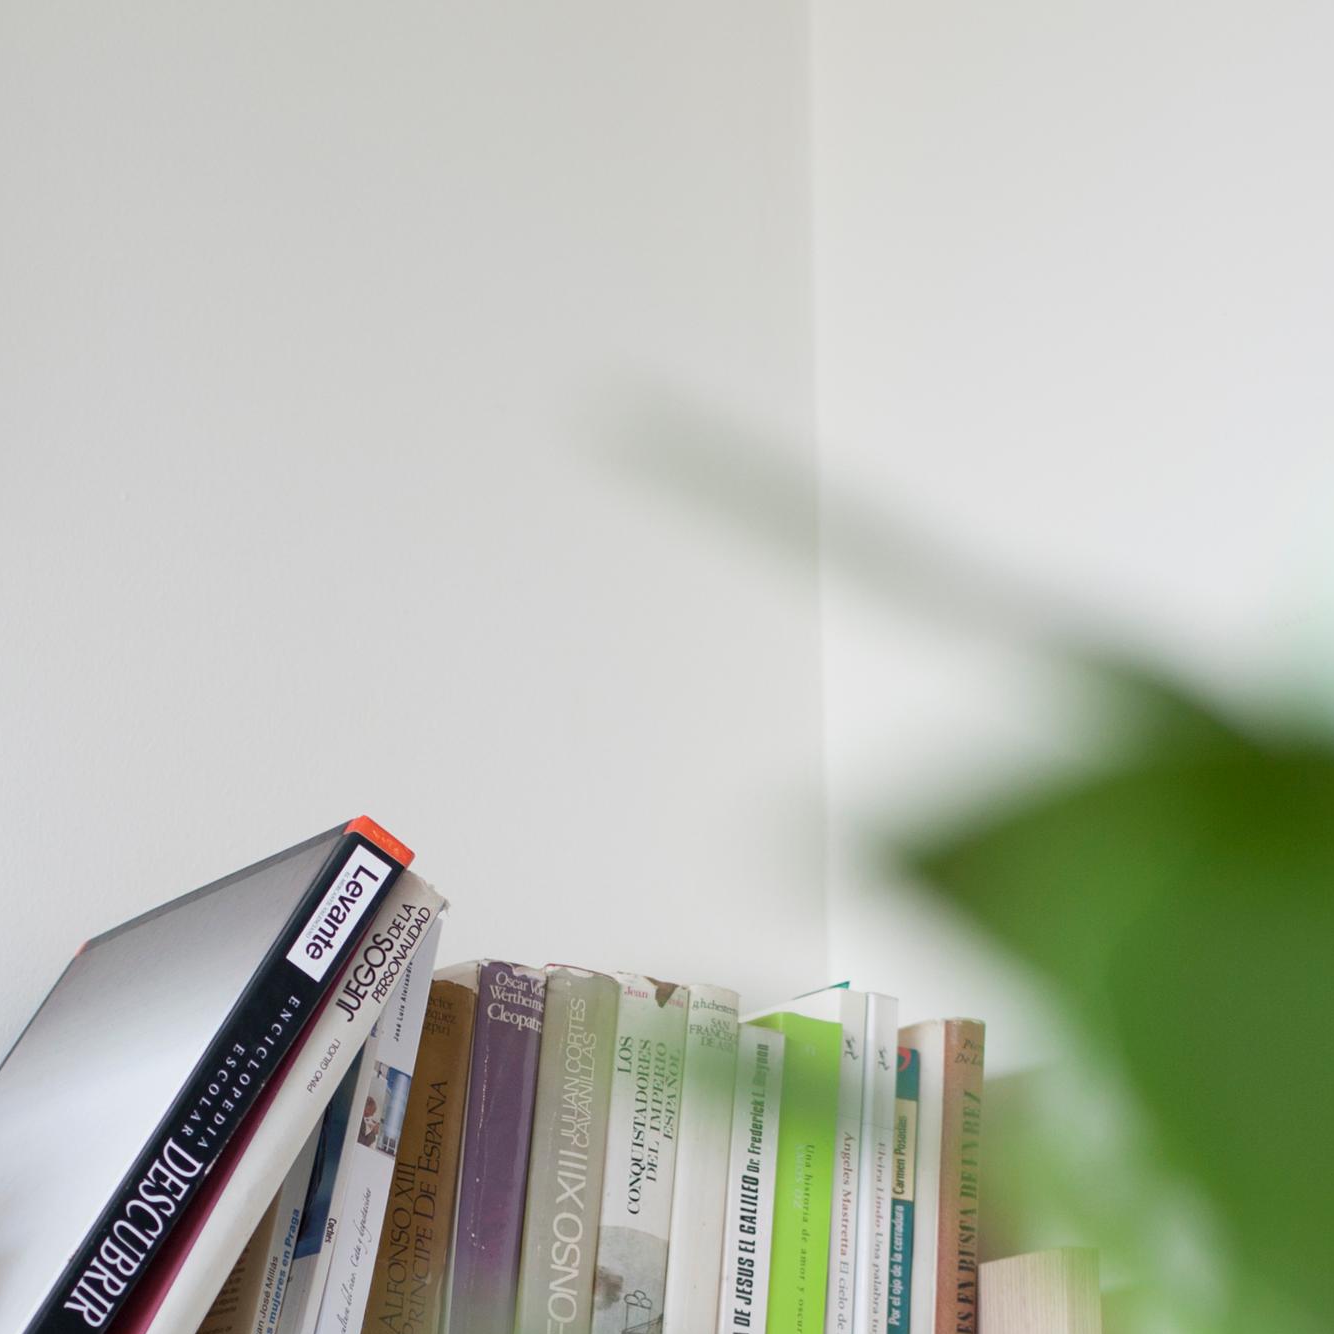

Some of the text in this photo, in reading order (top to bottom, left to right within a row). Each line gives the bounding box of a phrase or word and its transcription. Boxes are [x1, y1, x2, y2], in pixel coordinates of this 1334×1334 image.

[305, 864, 379, 960] Levante
[336, 903, 417, 1023] JUEGOS DE LA
[371, 907, 431, 1005] PERSONALIDAD
[495, 970, 529, 992] Oscar
[624, 985, 649, 1000] Jean
[398, 1003, 407, 1021] Luis
[710, 1018, 731, 1032] SAN
[197, 995, 301, 1149] ENCICLOPEDIA
[560, 998, 586, 1140] JULIAN CORTES
[617, 1036, 634, 1075] LOS
[181, 1043, 245, 1137] ESCOLAR
[307, 1069, 324, 1094] PINO
[570, 1032, 597, 1149] CAVANILLAS
[663, 1049, 681, 1141] ESPAÑOL
[417, 1079, 448, 1176] ESPAÑA
[627, 1039, 652, 1216] CONQUISTADORES
[645, 1042, 667, 1183] DEL IMPERIO
[747, 1099, 765, 1156] Frederick
[746, 1156, 760, 1174] Dr.
[804, 1144, 815, 1168] Una
[874, 1141, 886, 1183] Elvira
[892, 1154, 907, 1196] Carmen
[394, 1160, 416, 1200] XIII
[556, 1149, 589, 1211] XIII
[802, 1174, 815, 1222] historia
[413, 1183, 437, 1221] DE
[739, 1174, 759, 1236] GALILEO
[873, 1187, 884, 1228] Lindo
[64, 1137, 204, 1328] DESCUBRIR
[284, 1208, 300, 1249] Praga
[324, 1217, 337, 1244] Coches
[800, 1228, 810, 1243] de
[839, 1190, 852, 1257] Mastretta
[957, 1206, 978, 1274] BUSCA
[282, 1250, 291, 1266] en
[738, 1239, 755, 1254] EL
[798, 1248, 809, 1281] amor
[873, 1232, 884, 1260] Una
[888, 1205, 905, 1326] Por el ojo de la cerradura
[260, 1290, 271, 1317] José
[266, 1256, 278, 1288] Millás
[380, 1206, 412, 1334] ALFONSO
[735, 1256, 755, 1306] JESUS
[838, 1260, 849, 1275] El
[871, 1263, 884, 1314] palabra
[269, 1270, 287, 1323] mujeres
[837, 1276, 849, 1310] cielo
[956, 1277, 976, 1307] EN
[734, 1308, 752, 1328] DE
[836, 1312, 847, 1330] de
